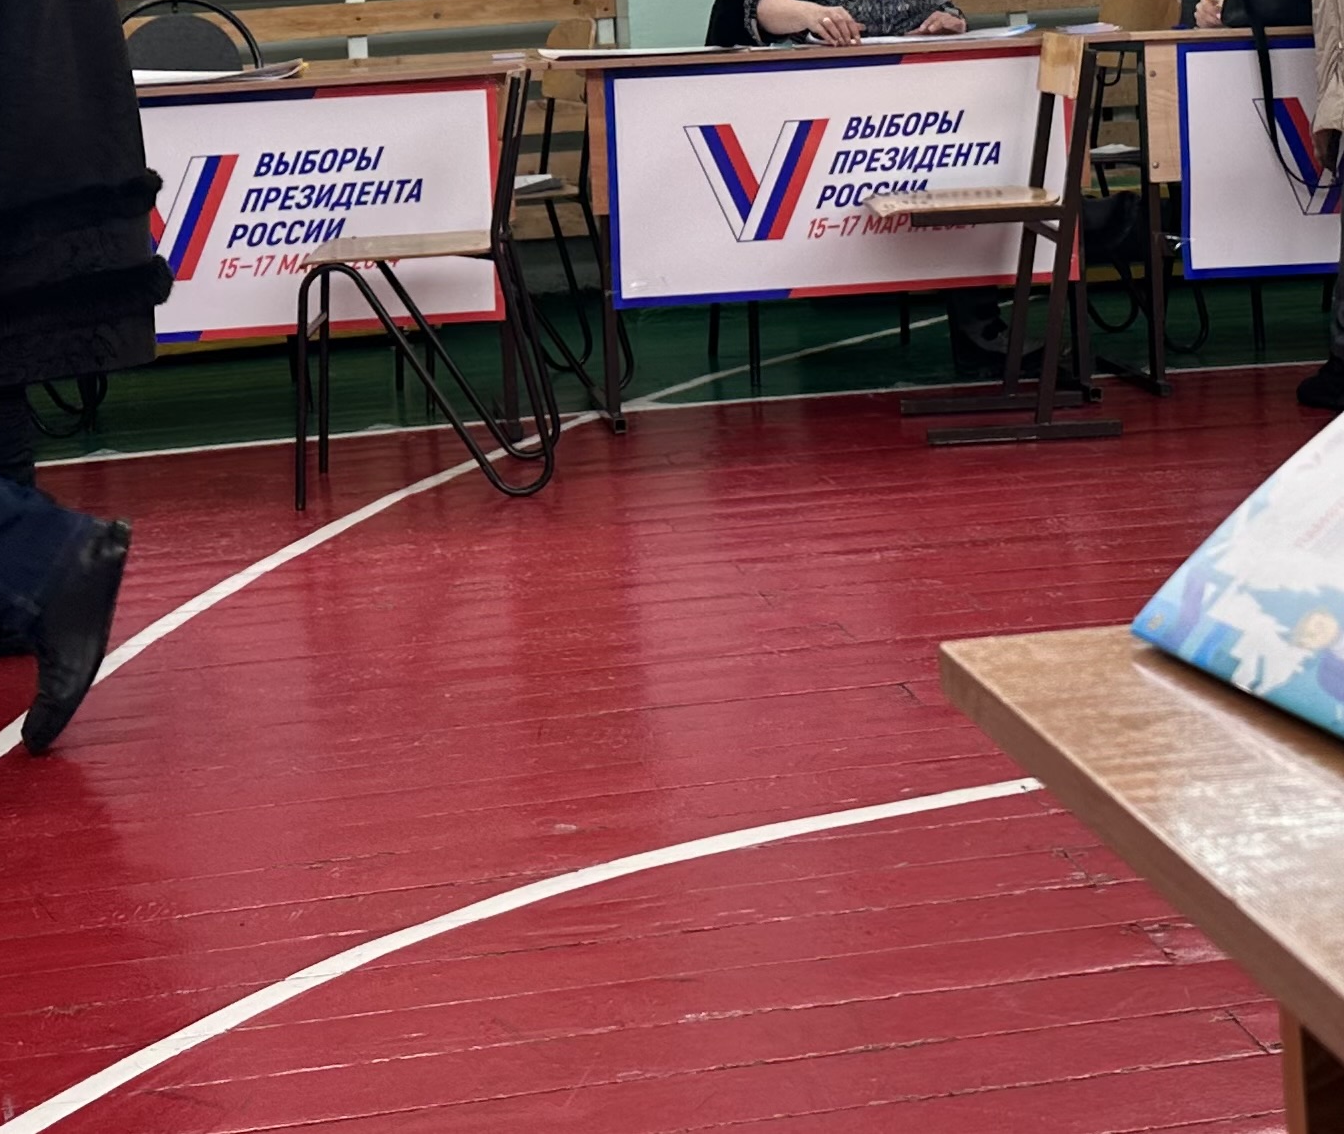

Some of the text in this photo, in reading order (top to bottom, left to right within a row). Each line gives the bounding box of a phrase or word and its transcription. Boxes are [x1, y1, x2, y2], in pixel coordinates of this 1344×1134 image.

[842, 109, 965, 141] ВЫБОРЫ
[253, 146, 385, 178] ВЫБОРЫ
[828, 141, 1002, 176] ПРЕЗИДЕНТА
[240, 178, 424, 213] ПРЕЗИДЕНТА
[226, 217, 346, 249] РОССИИ
[862, 213, 928, 236] МАР
